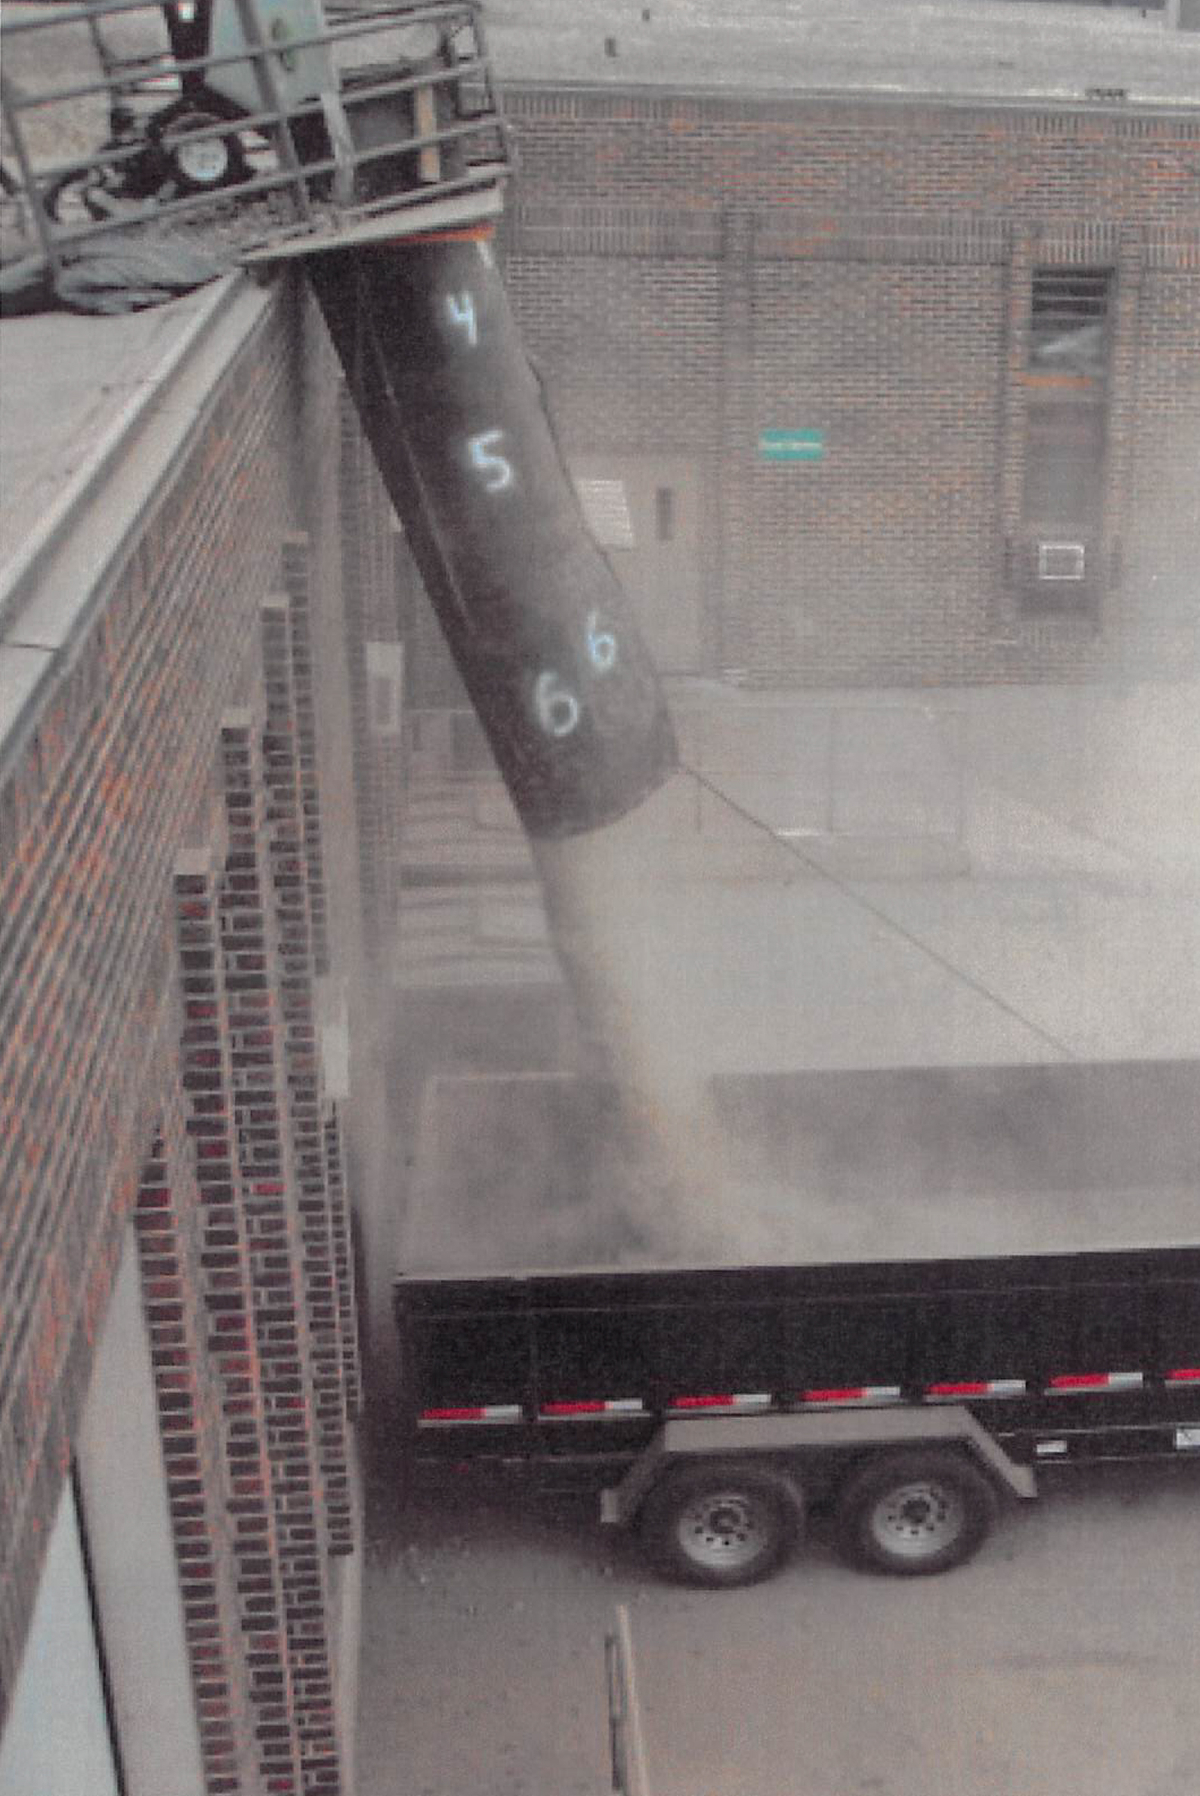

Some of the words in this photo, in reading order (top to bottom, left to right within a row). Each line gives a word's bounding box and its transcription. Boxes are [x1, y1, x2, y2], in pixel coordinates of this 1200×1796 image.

[446, 292, 478, 345] 4
[467, 429, 512, 493] 5
[586, 610, 616, 672] 6
[535, 671, 578, 736] 6
